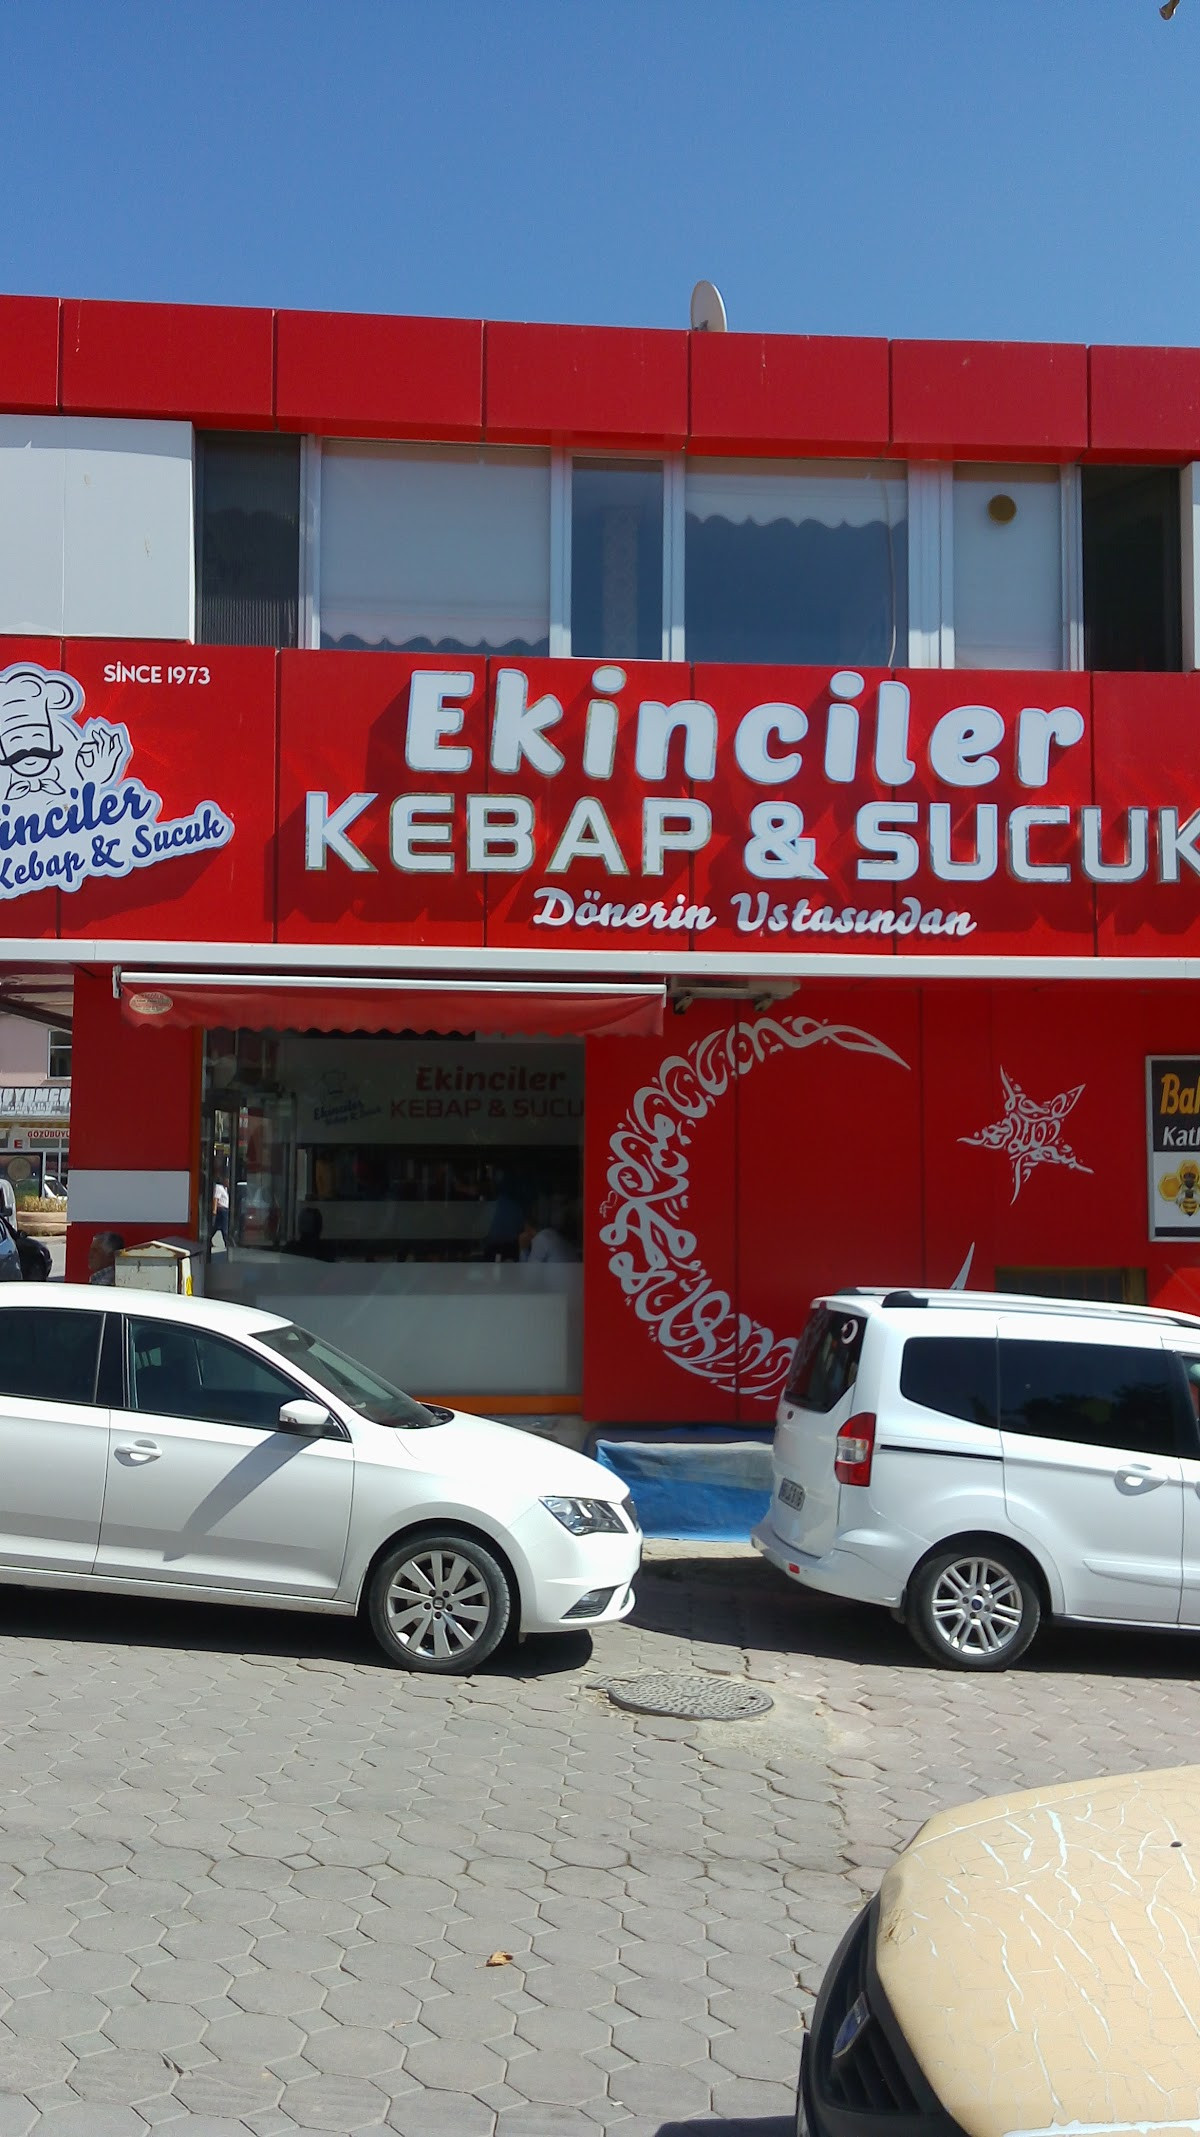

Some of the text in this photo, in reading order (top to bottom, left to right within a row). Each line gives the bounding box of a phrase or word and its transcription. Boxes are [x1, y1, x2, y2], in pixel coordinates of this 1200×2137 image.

[104, 660, 211, 686] SİNCE 1973
[403, 666, 1086, 789] Ekinciler
[0, 780, 152, 851] inciler
[92, 835, 125, 869] &
[132, 808, 224, 859] Sucuk
[304, 790, 1200, 884] KEBAP & SUCUK
[532, 887, 978, 940] Dönerin Ustasından
[415, 1065, 567, 1092] Ekinciler
[390, 1099, 482, 1119] KEBAP
[487, 1099, 508, 1118] &
